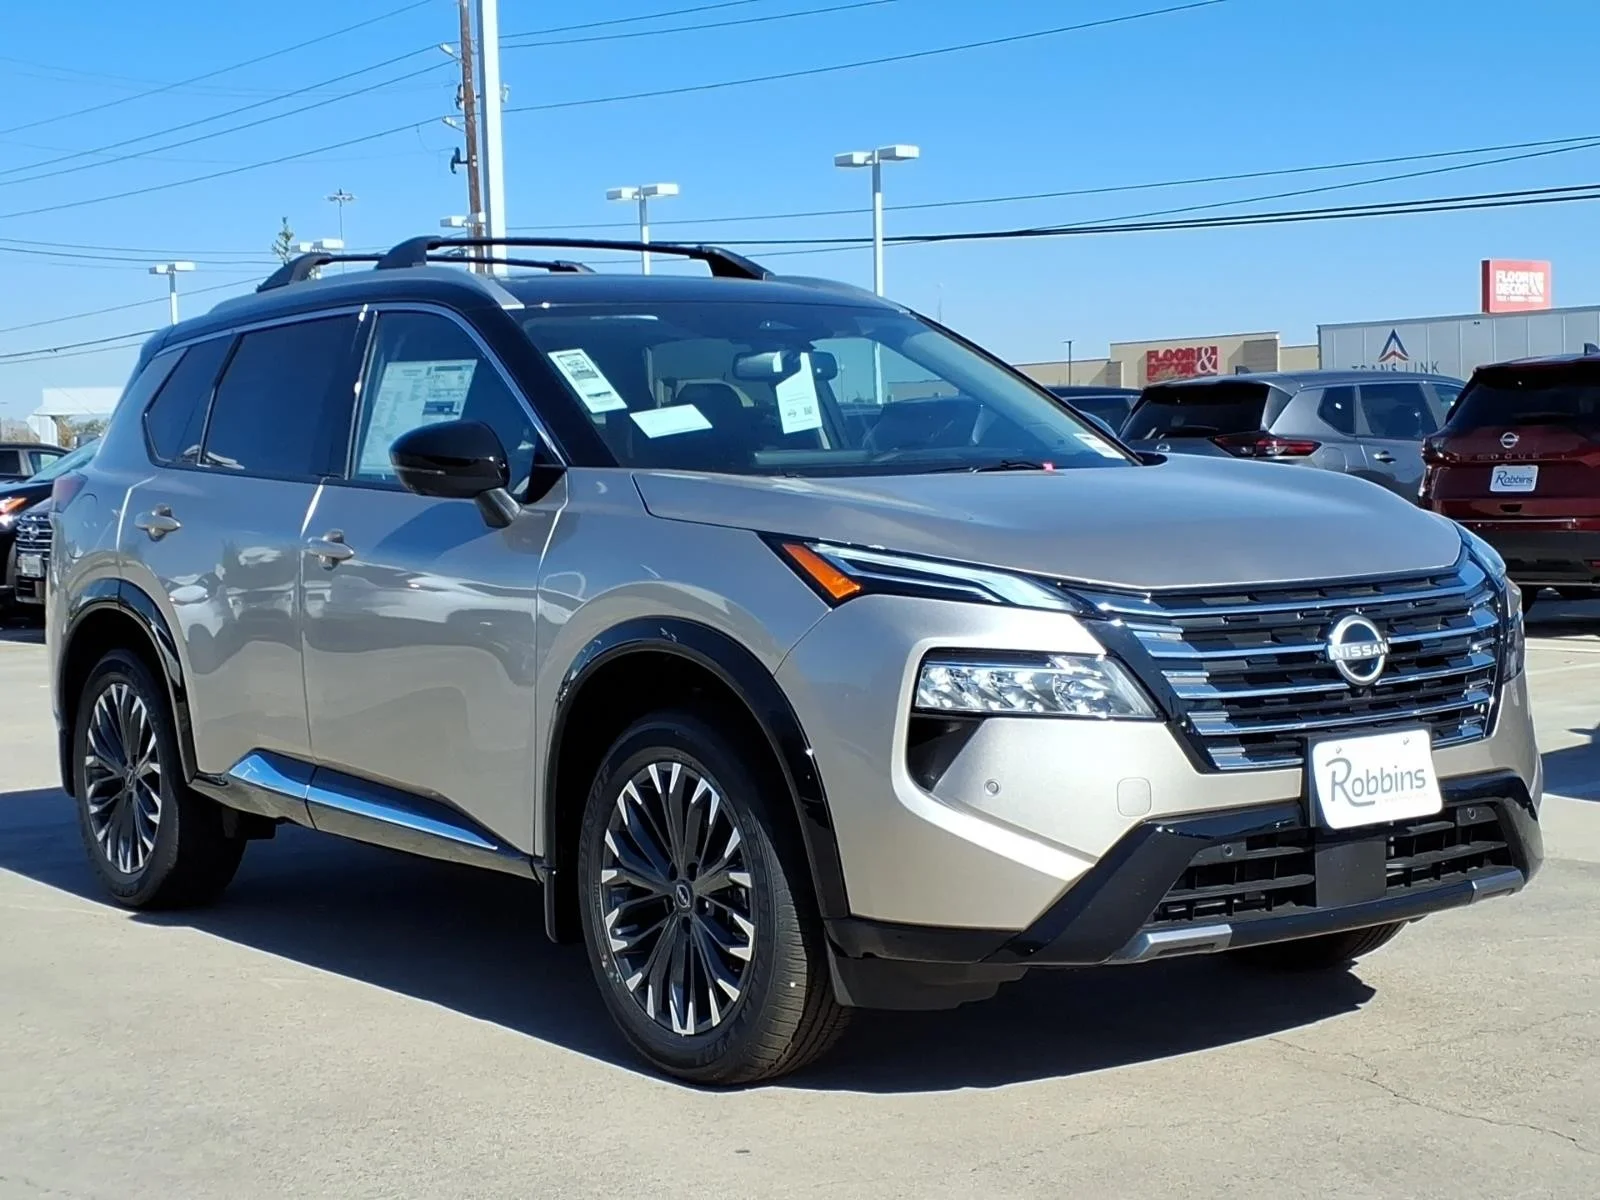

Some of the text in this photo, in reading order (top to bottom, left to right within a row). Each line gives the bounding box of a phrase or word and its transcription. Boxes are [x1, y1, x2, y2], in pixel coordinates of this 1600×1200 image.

[1147, 346, 1218, 374] FLOOR &
[1495, 470, 1534, 487] Robbins
[1330, 642, 1389, 660] NISSAN
[1325, 757, 1426, 807] Robbins
